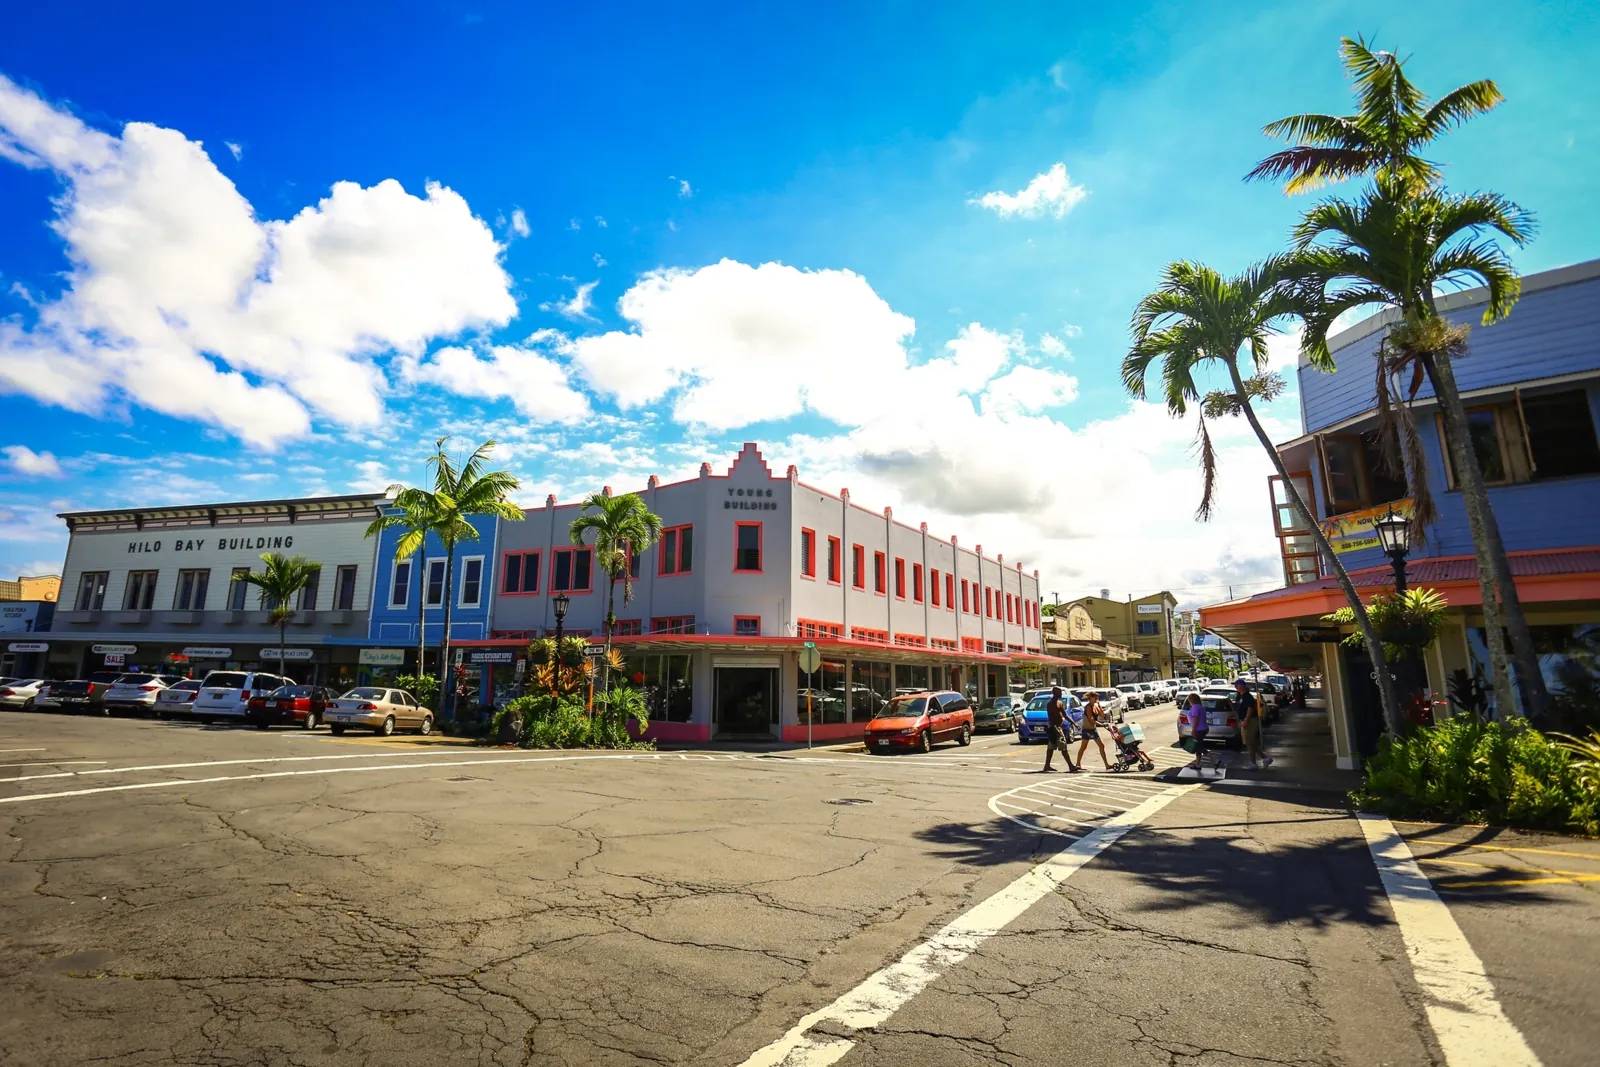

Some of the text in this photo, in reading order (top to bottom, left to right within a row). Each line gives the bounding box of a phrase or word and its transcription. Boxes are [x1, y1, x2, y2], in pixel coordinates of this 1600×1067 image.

[727, 487, 773, 498] YOUNG
[723, 500, 777, 510] BUILDING
[1357, 509, 1403, 526] NOW LEASNG
[128, 535, 294, 553] HILO BAY BUILDING
